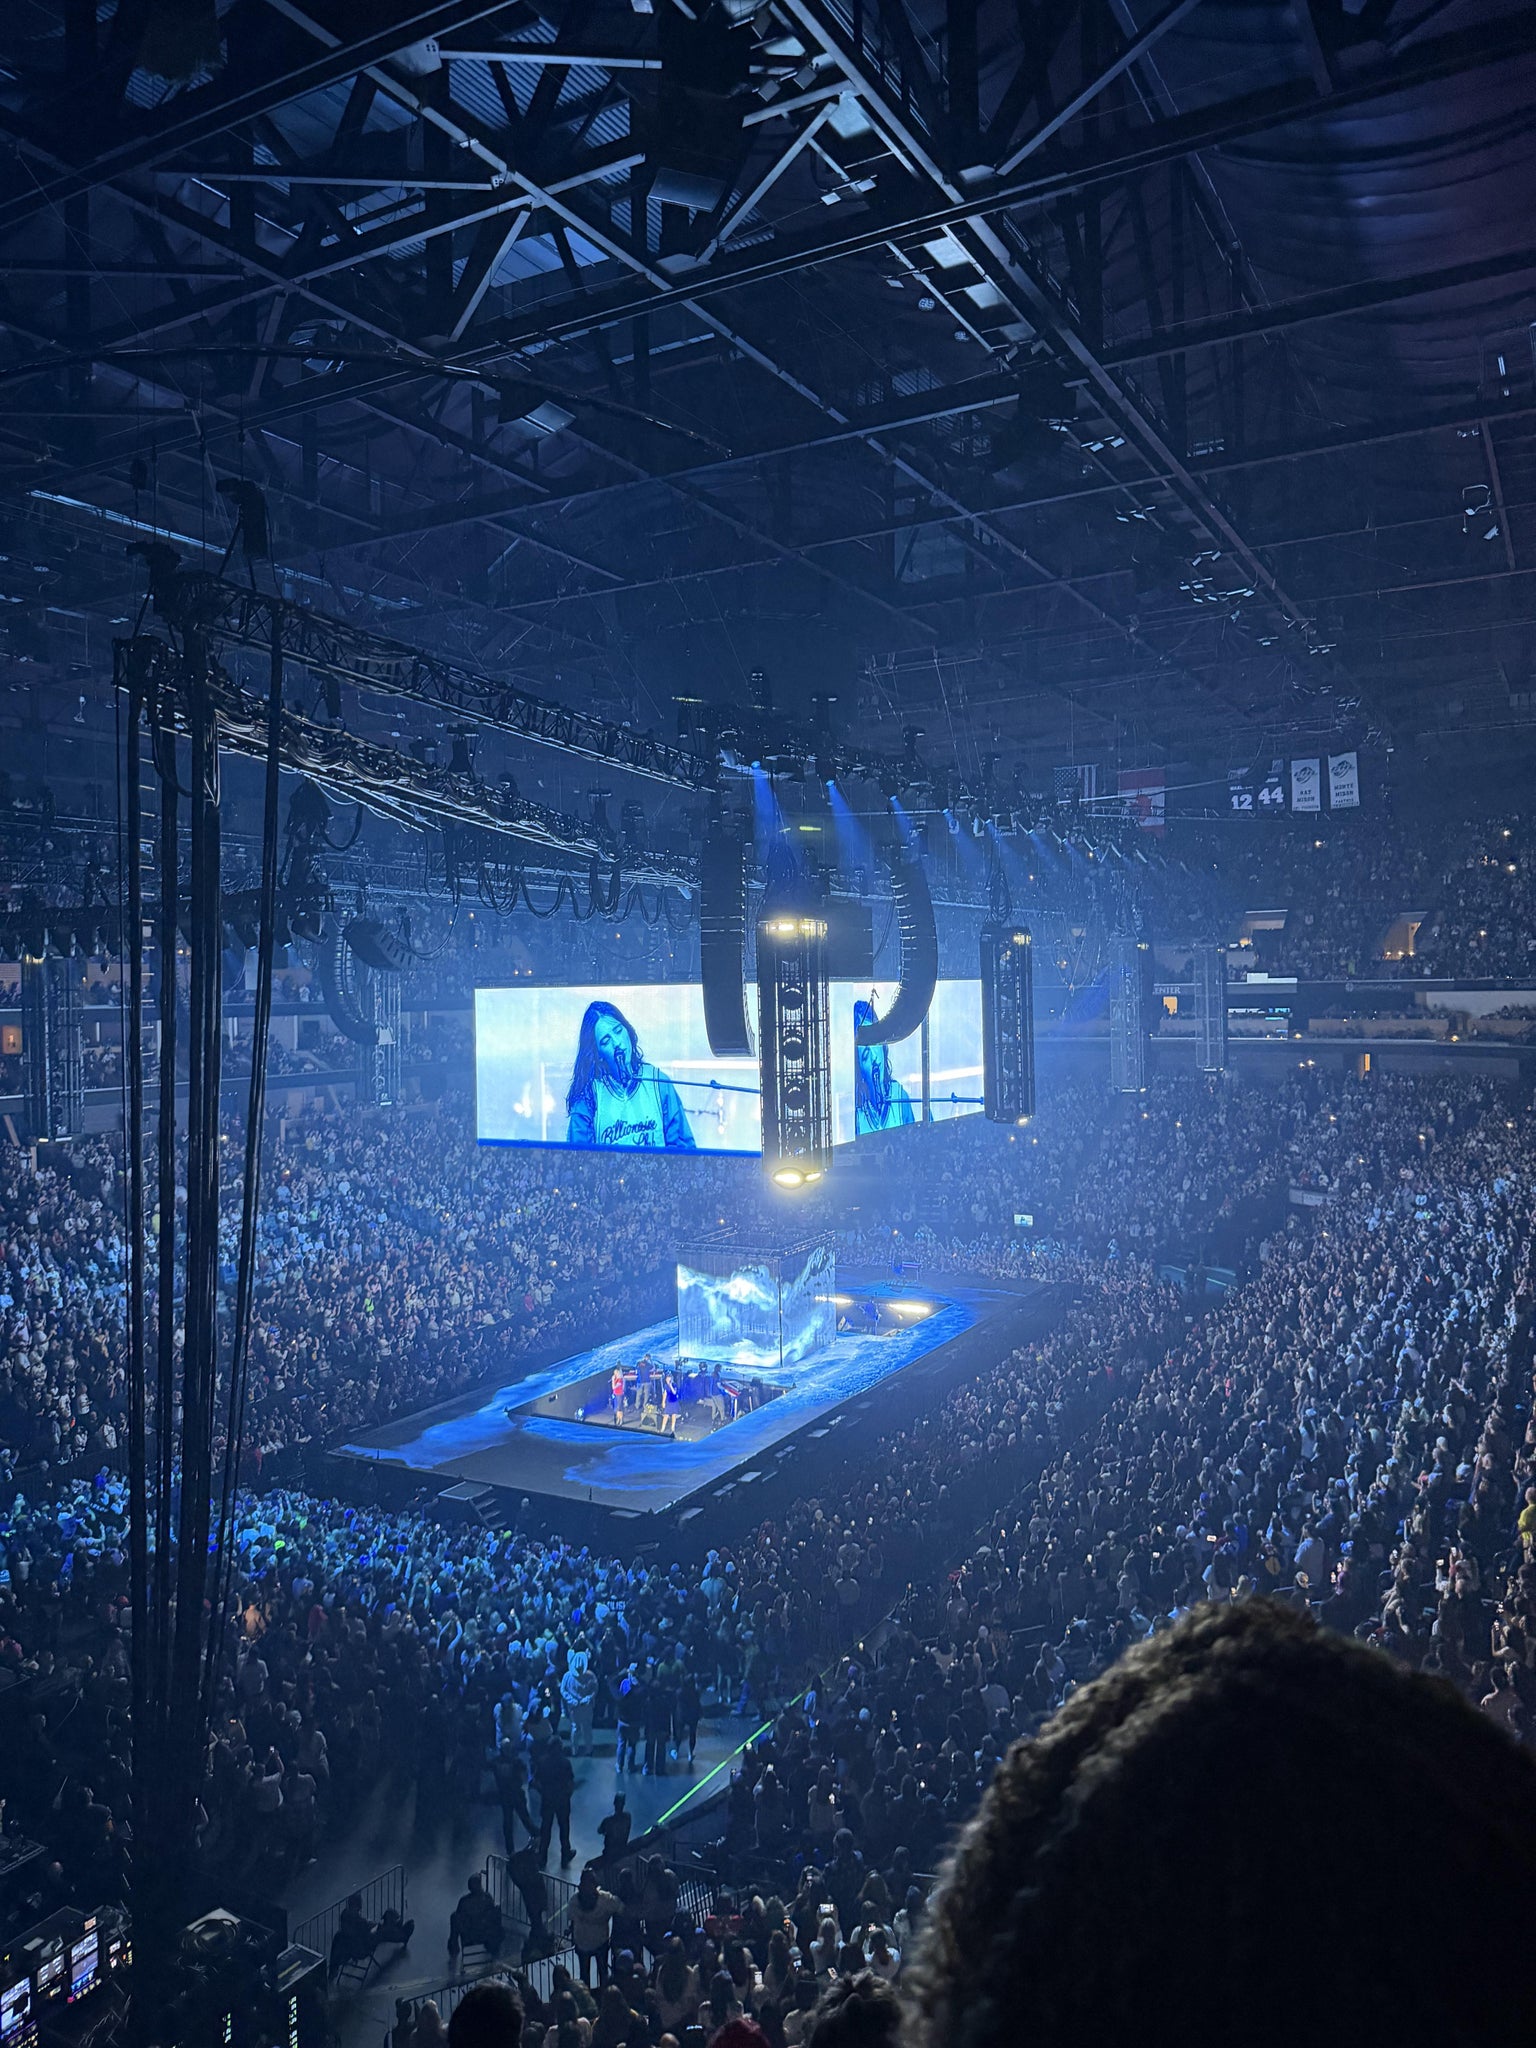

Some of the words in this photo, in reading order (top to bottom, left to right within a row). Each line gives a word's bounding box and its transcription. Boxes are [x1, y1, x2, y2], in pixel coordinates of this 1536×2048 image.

[1231, 793, 1253, 810] 12
[1258, 786, 1284, 805] 44
[1152, 986, 1181, 994] ENTER
